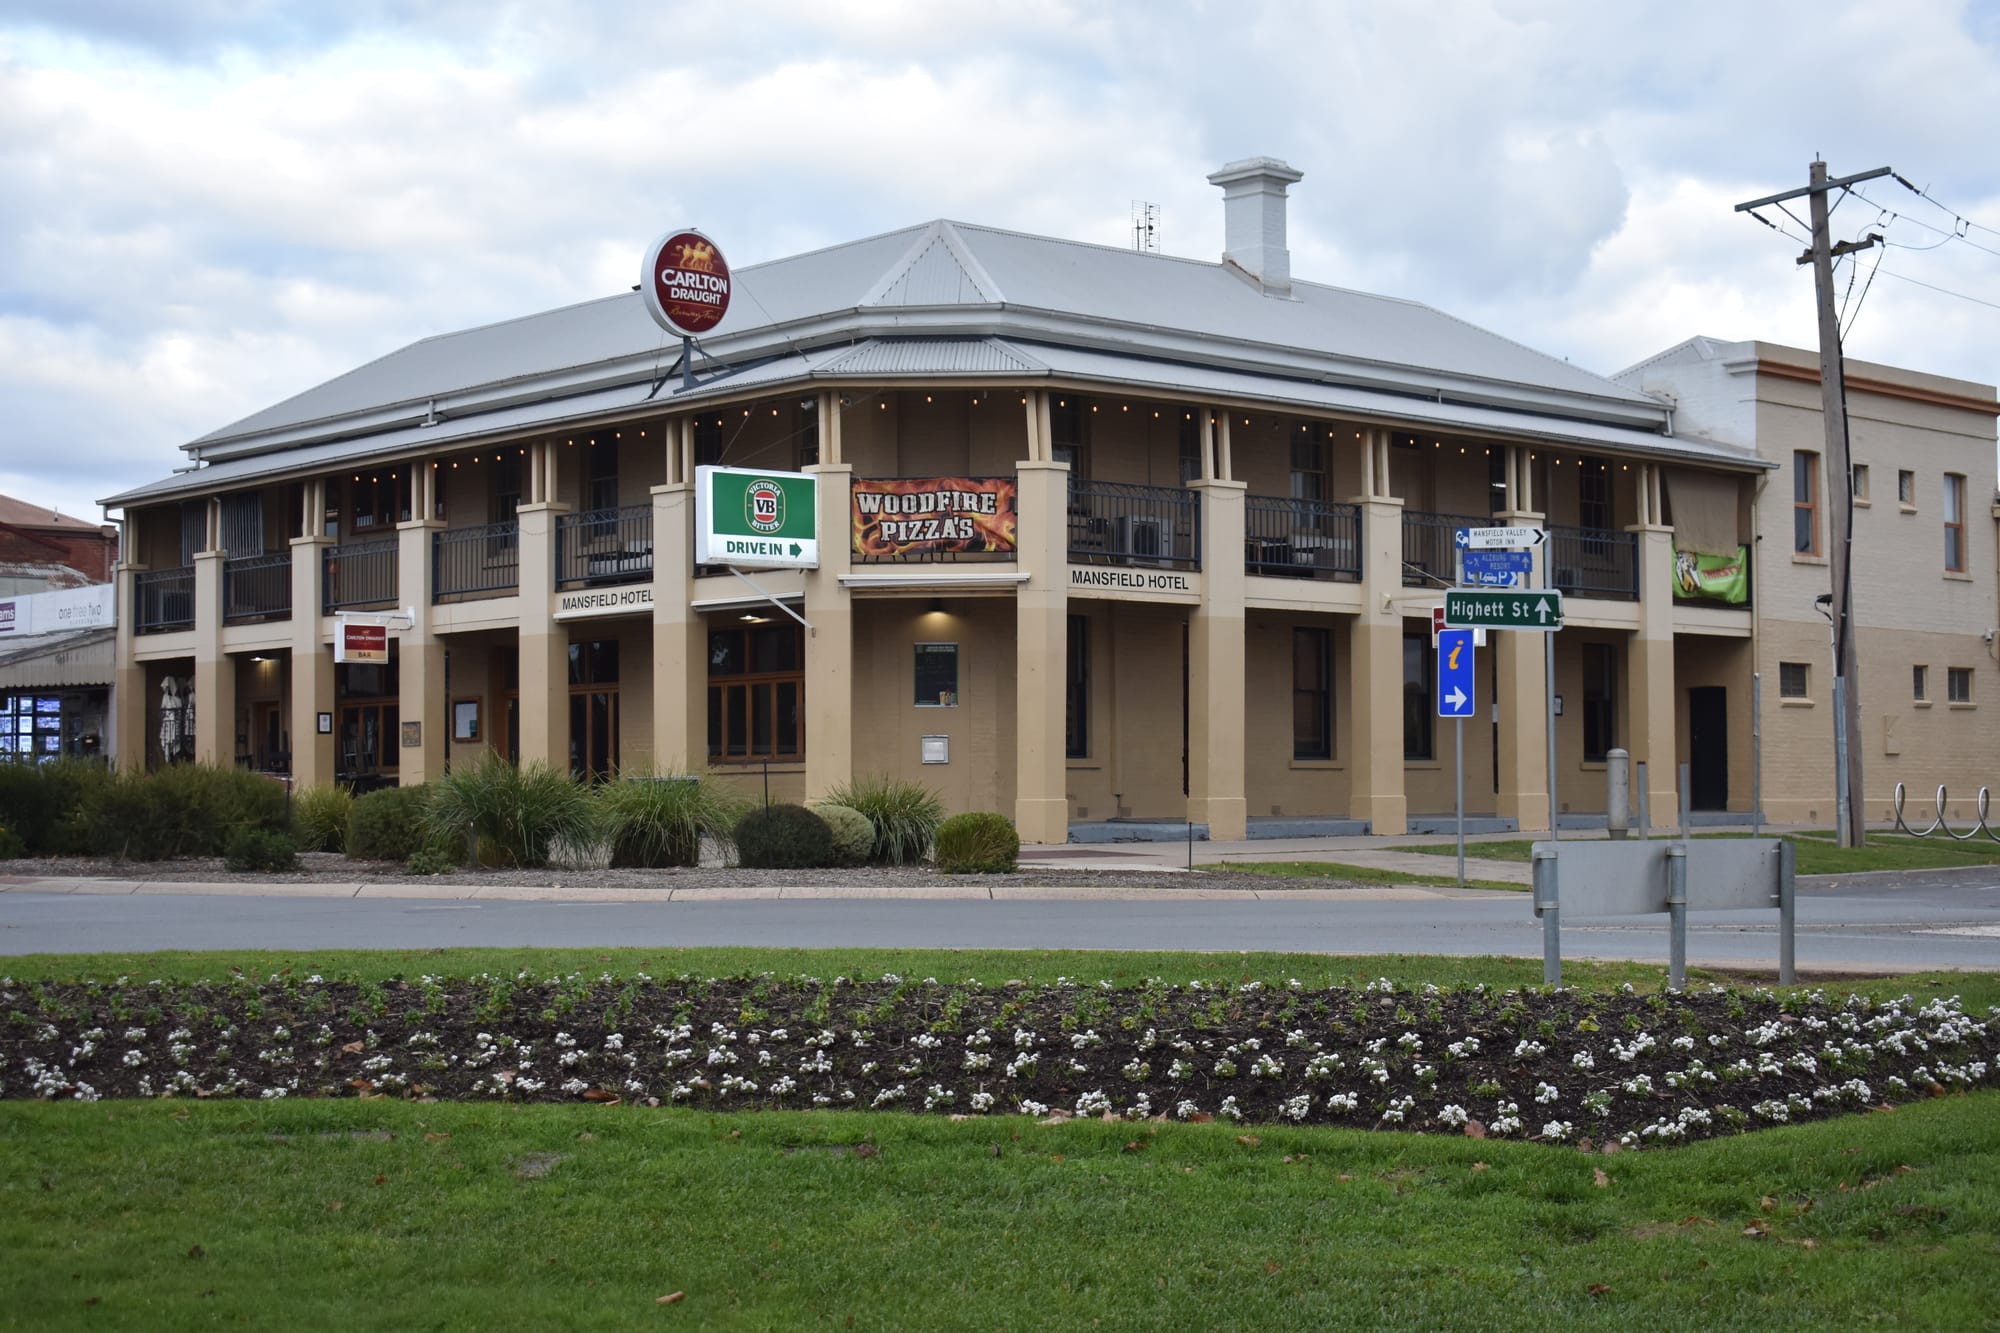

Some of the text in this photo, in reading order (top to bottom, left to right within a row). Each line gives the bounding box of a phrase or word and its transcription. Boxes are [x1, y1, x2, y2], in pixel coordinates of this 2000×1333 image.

[661, 268, 728, 294] CARLTON
[671, 287, 722, 305] DRAUGHT
[749, 482, 781, 496] VICTORIA
[756, 499, 775, 514] VB
[856, 490, 997, 515] WOODFIRE
[752, 520, 780, 531] BITTER
[880, 516, 974, 541] PIZZA'S
[1473, 529, 1527, 537] MANSFIELD VALLEY
[726, 541, 783, 556] DRIVE IN
[1485, 538, 1503, 546] MOTOR
[1072, 570, 1189, 590] MANSFIELD HOTEL
[562, 589, 654, 610] MANSFIELD HOTEL
[1451, 600, 1529, 621] Highett St
